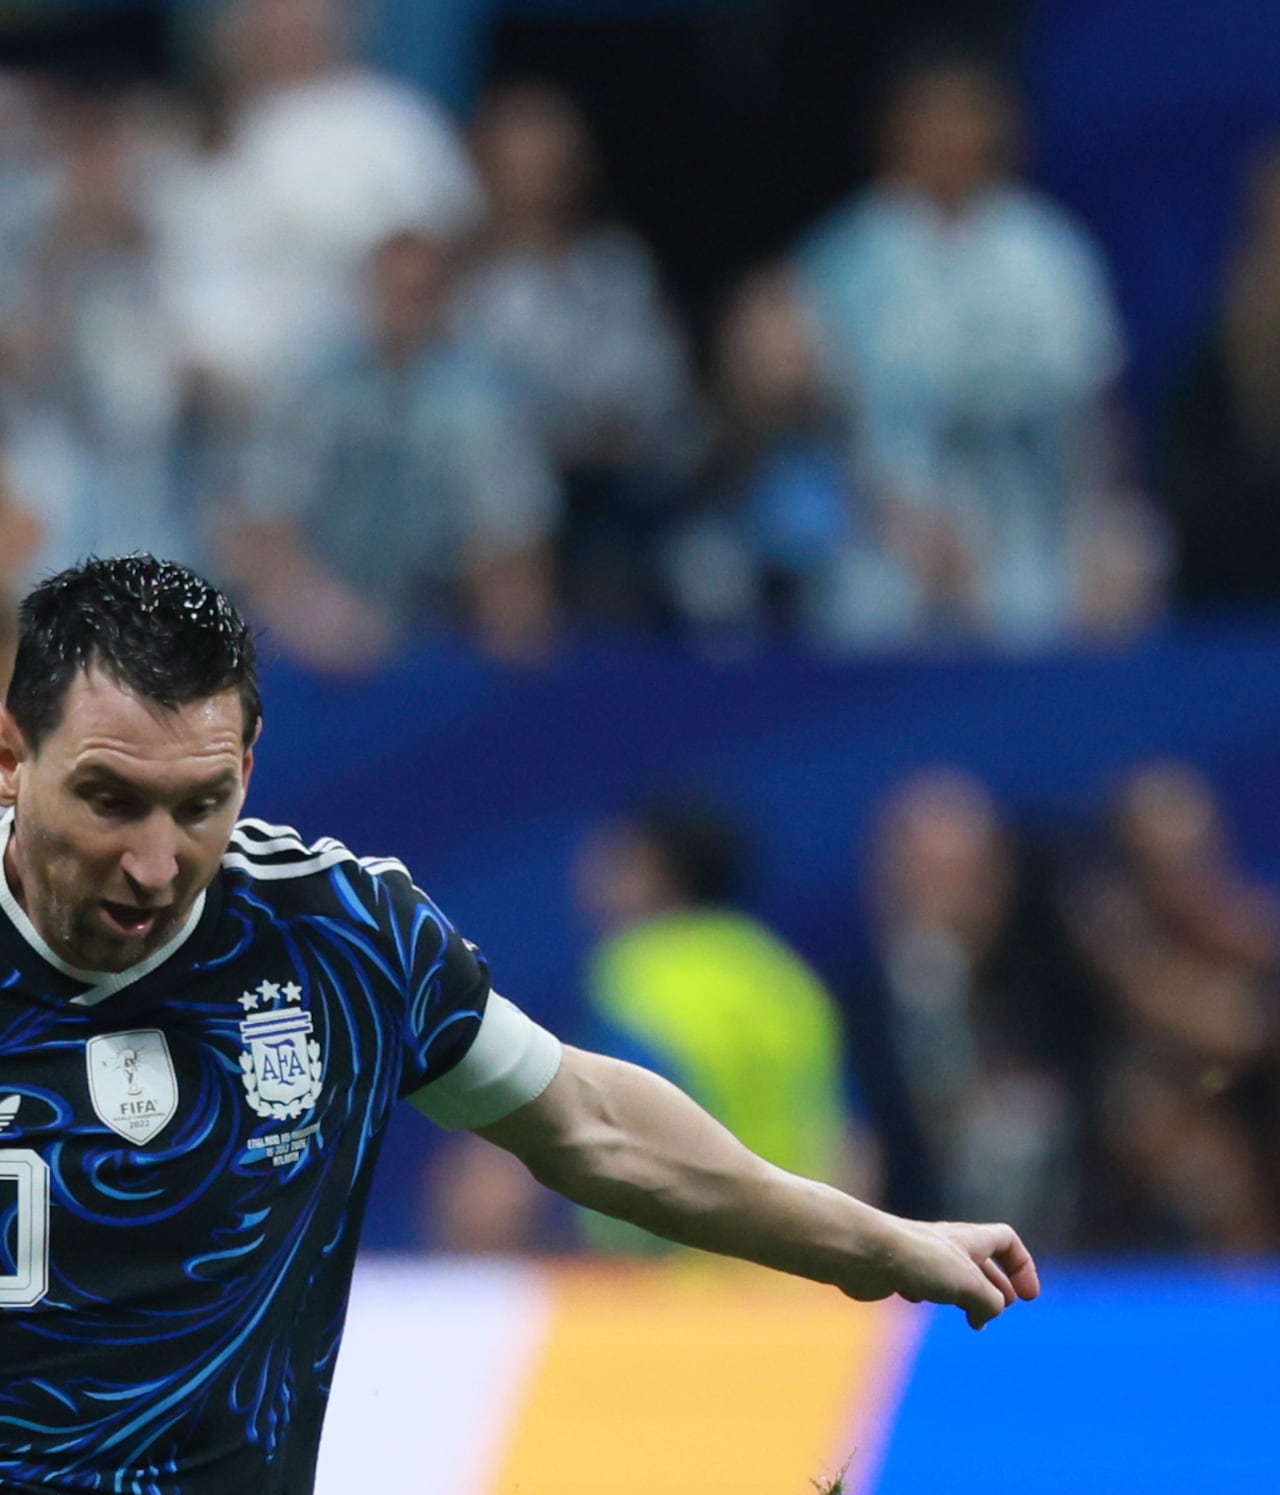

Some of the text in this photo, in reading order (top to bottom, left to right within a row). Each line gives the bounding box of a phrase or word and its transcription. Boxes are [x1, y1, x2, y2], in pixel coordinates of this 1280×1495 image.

[261, 1038, 306, 1087] AFA
[120, 1100, 157, 1115] FIFA
[129, 1119, 151, 1129] 2022
